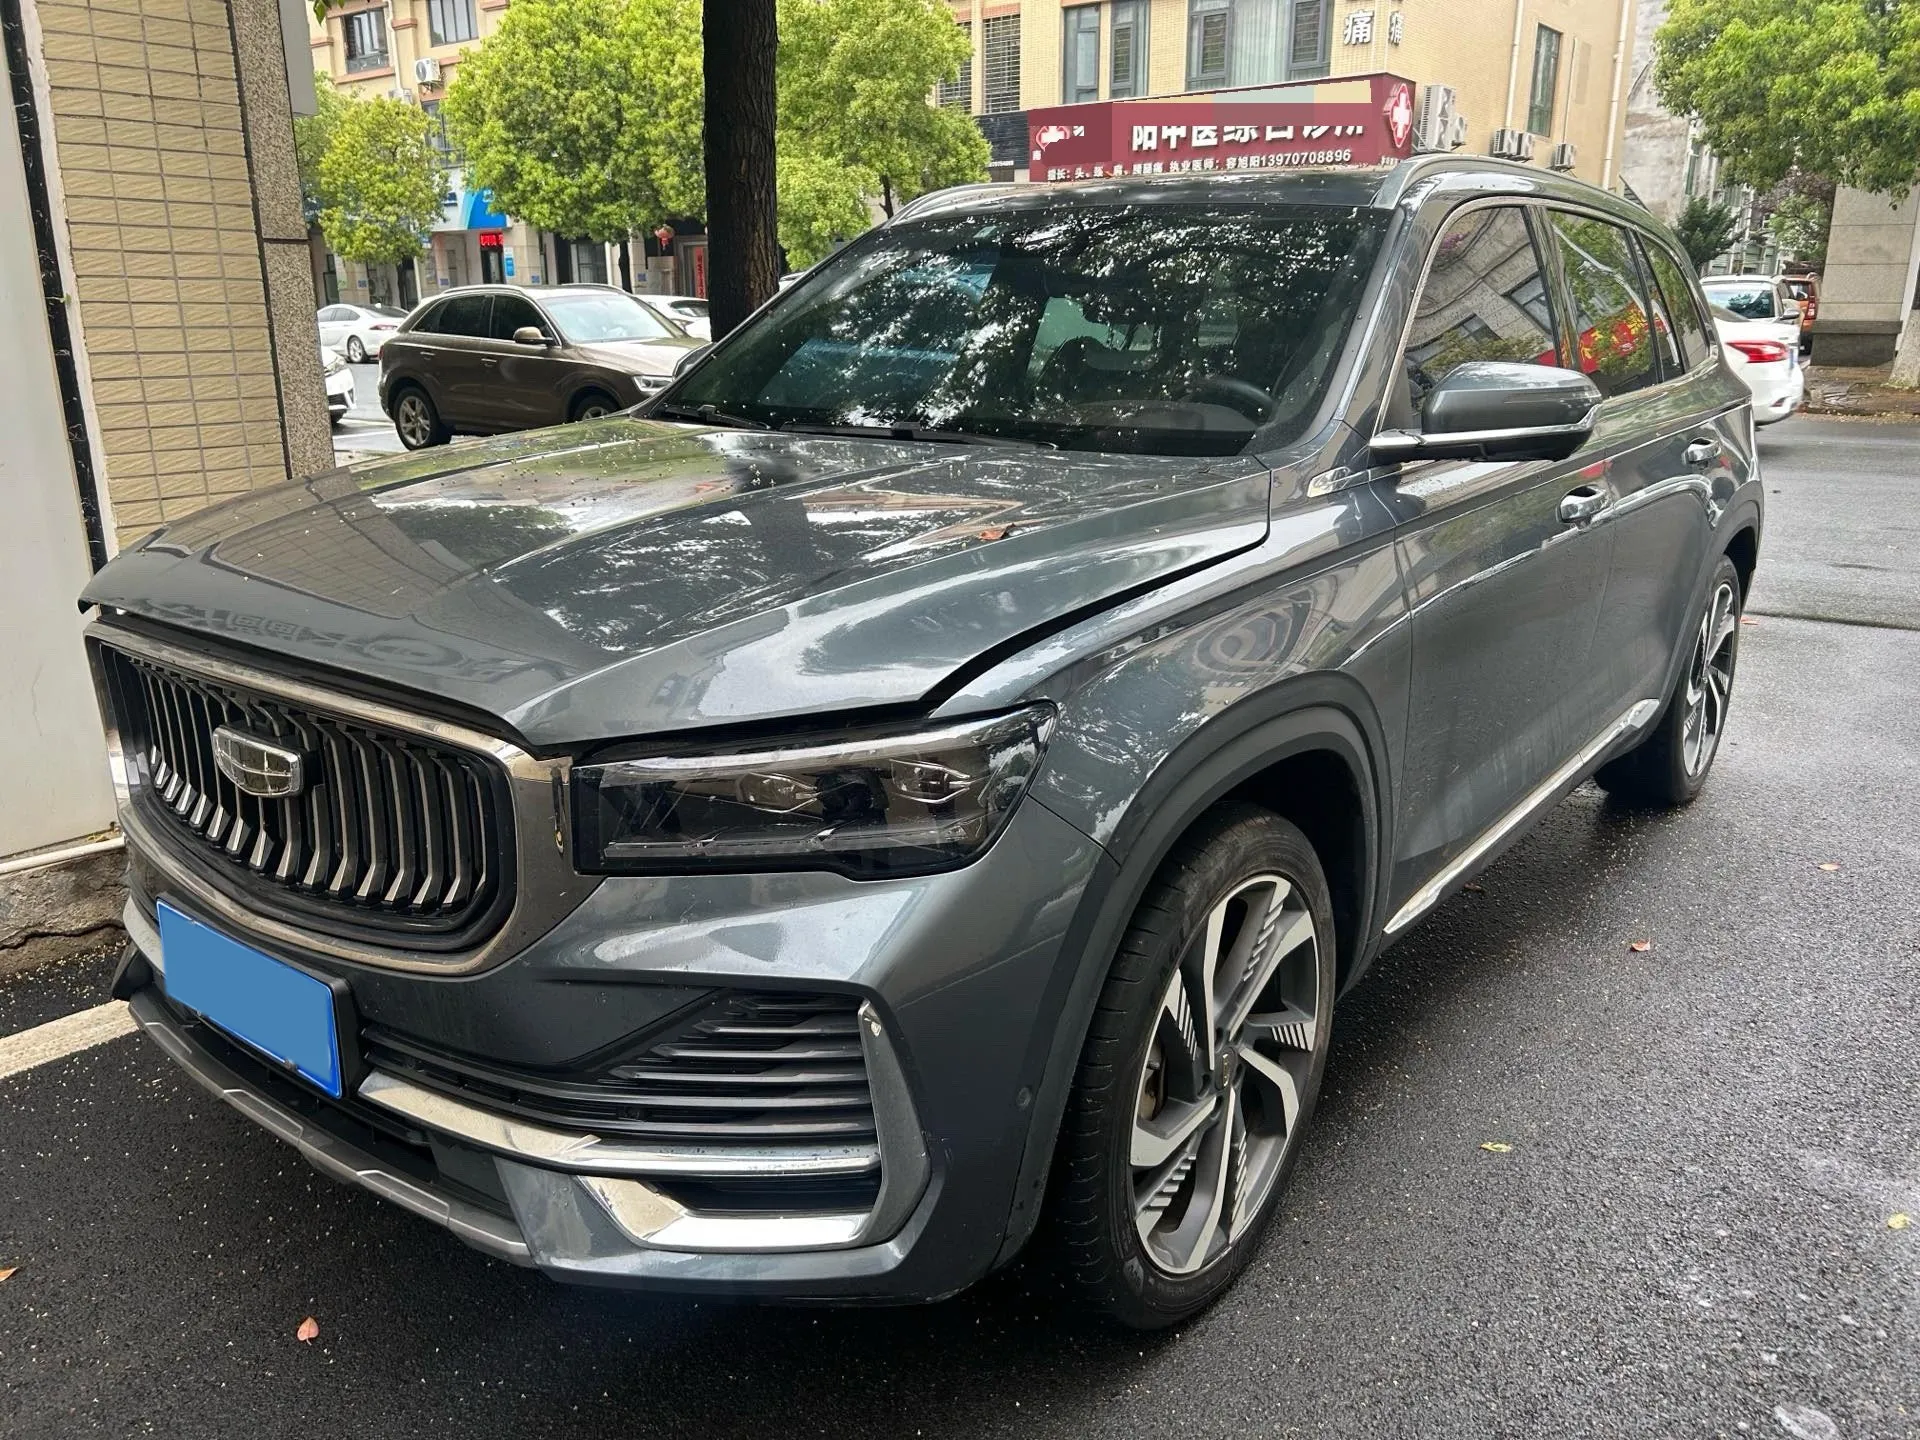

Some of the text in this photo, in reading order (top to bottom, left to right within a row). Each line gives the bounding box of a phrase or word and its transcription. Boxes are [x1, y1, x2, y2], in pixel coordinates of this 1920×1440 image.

[1343, 9, 1374, 45] 痛
[1132, 126, 1363, 151] 阳中医综
